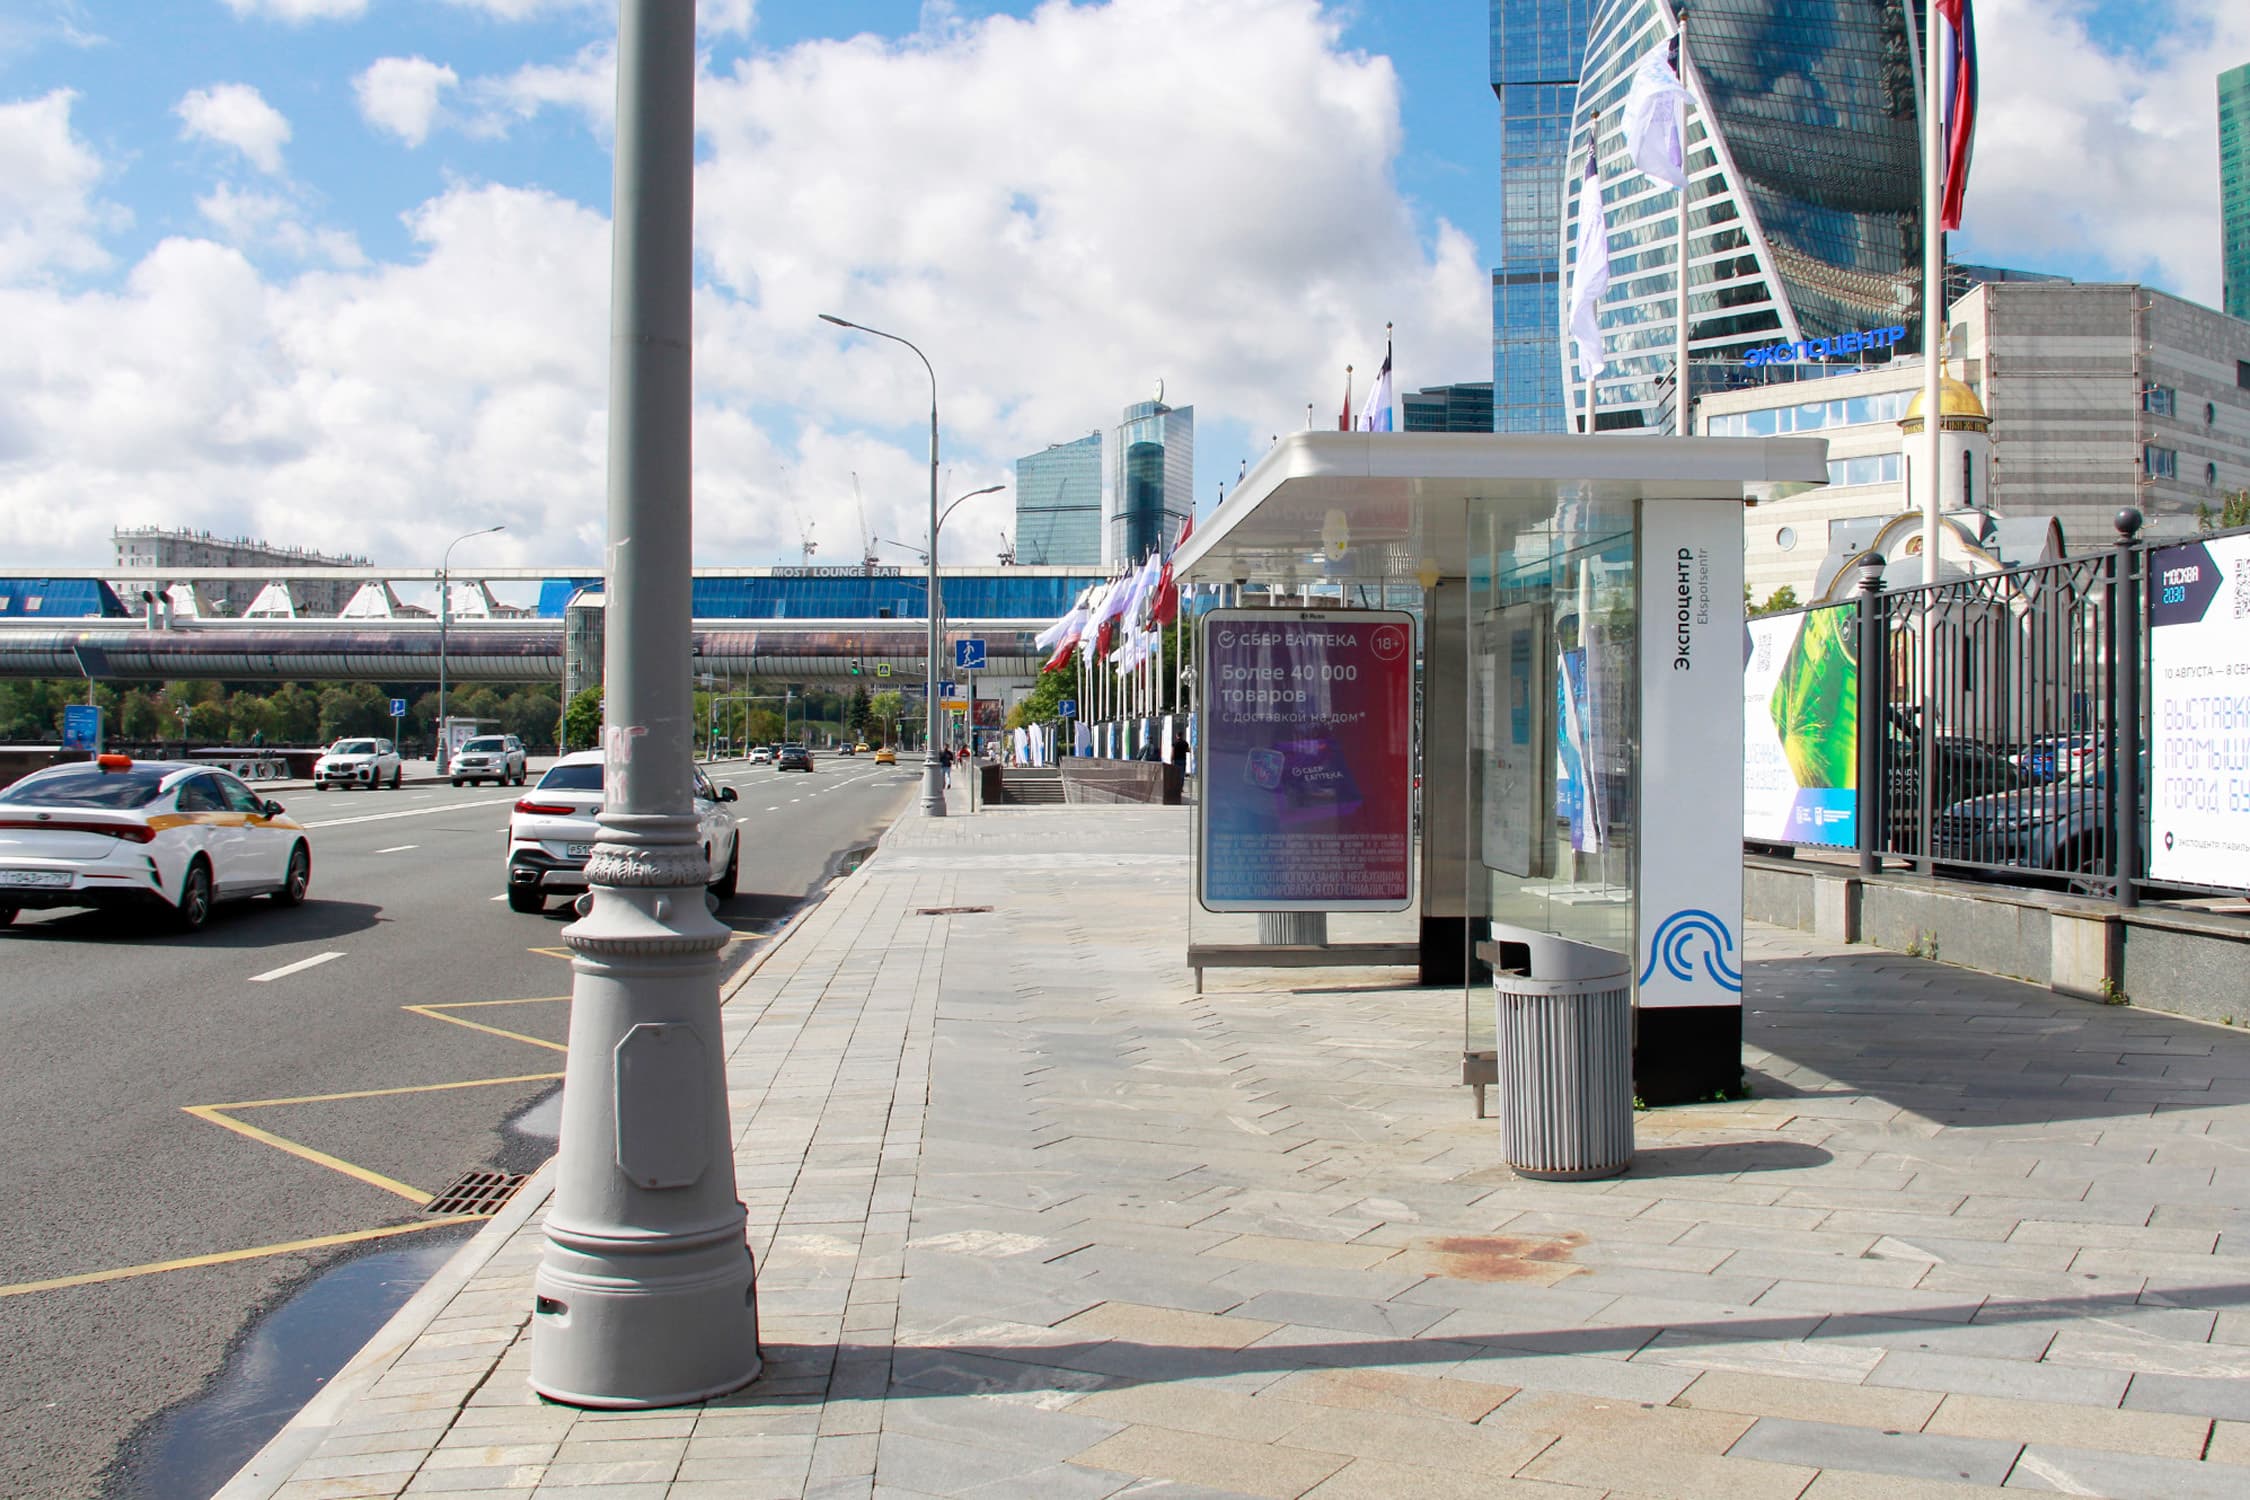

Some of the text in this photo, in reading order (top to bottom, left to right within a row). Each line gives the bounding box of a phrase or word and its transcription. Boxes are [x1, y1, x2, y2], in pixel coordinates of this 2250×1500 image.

[1743, 325, 1906, 369] ЭКСПОЦЕНТР
[772, 567, 900, 577] MOST LOUNGE BAR
[2163, 566, 2199, 586] МОСКВА
[2163, 585, 2185, 604] 2030
[1673, 547, 1694, 671] Экспоцентр
[1239, 633, 1358, 647] СБЕР ЕАПТЕКА
[1376, 637, 1400, 650] 18+
[1222, 664, 1357, 681] Более 40 000
[2164, 668, 2173, 679] 10
[2175, 666, 2214, 678] АВГУСТА
[1222, 689, 1307, 705] товаров
[1234, 711, 1306, 724] доставкой
[1311, 712, 1327, 723] на
[2164, 777, 2220, 815] ГОРОД
